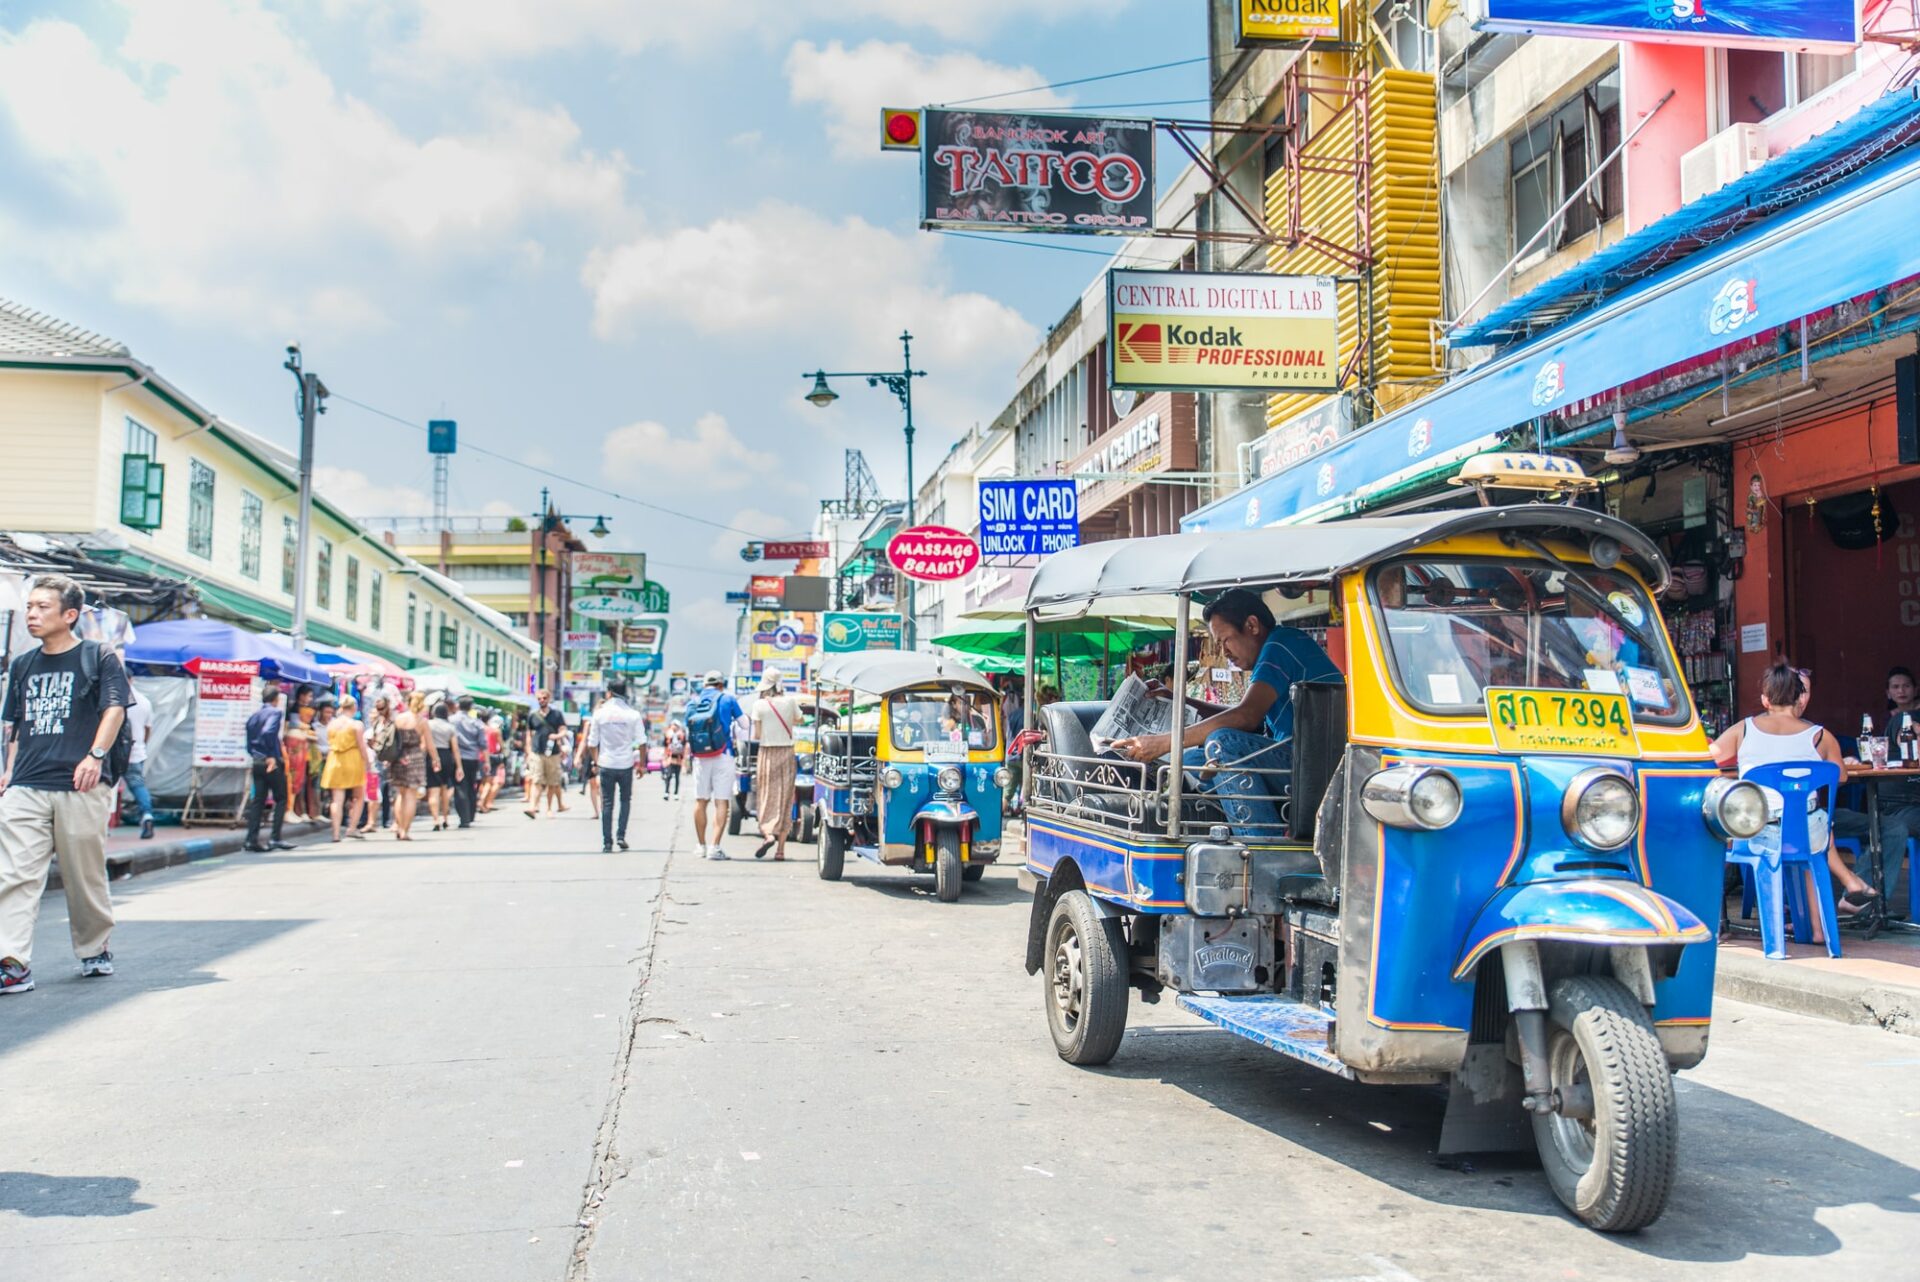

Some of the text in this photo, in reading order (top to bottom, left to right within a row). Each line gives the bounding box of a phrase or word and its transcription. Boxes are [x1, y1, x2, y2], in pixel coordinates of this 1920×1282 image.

[1251, 0, 1330, 14] Kodak
[1249, 13, 1333, 25] express
[974, 126, 1107, 144] BANGKOK ART
[934, 145, 1146, 203] TATTOO
[986, 210, 1067, 224] TATTOO
[1074, 213, 1148, 227] GROUP
[1117, 285, 1323, 311] CENTRAL DIGITAL LAB
[1167, 324, 1243, 346] Kodak
[1197, 348, 1326, 366] PROFESSIONAL
[1252, 371, 1327, 379] PRODUCTS
[1110, 412, 1159, 470] CENTER
[982, 487, 1075, 521] SIM CARD
[895, 542, 973, 559] MASSAGE
[983, 535, 1025, 552] UNLOCK
[1042, 534, 1076, 551] PHONE
[903, 558, 966, 575] BEAUTY
[200, 661, 258, 674] MASSAGE
[26, 671, 75, 699] STAR
[201, 683, 250, 695] MASSAGE
[1551, 697, 1625, 728] 7394
